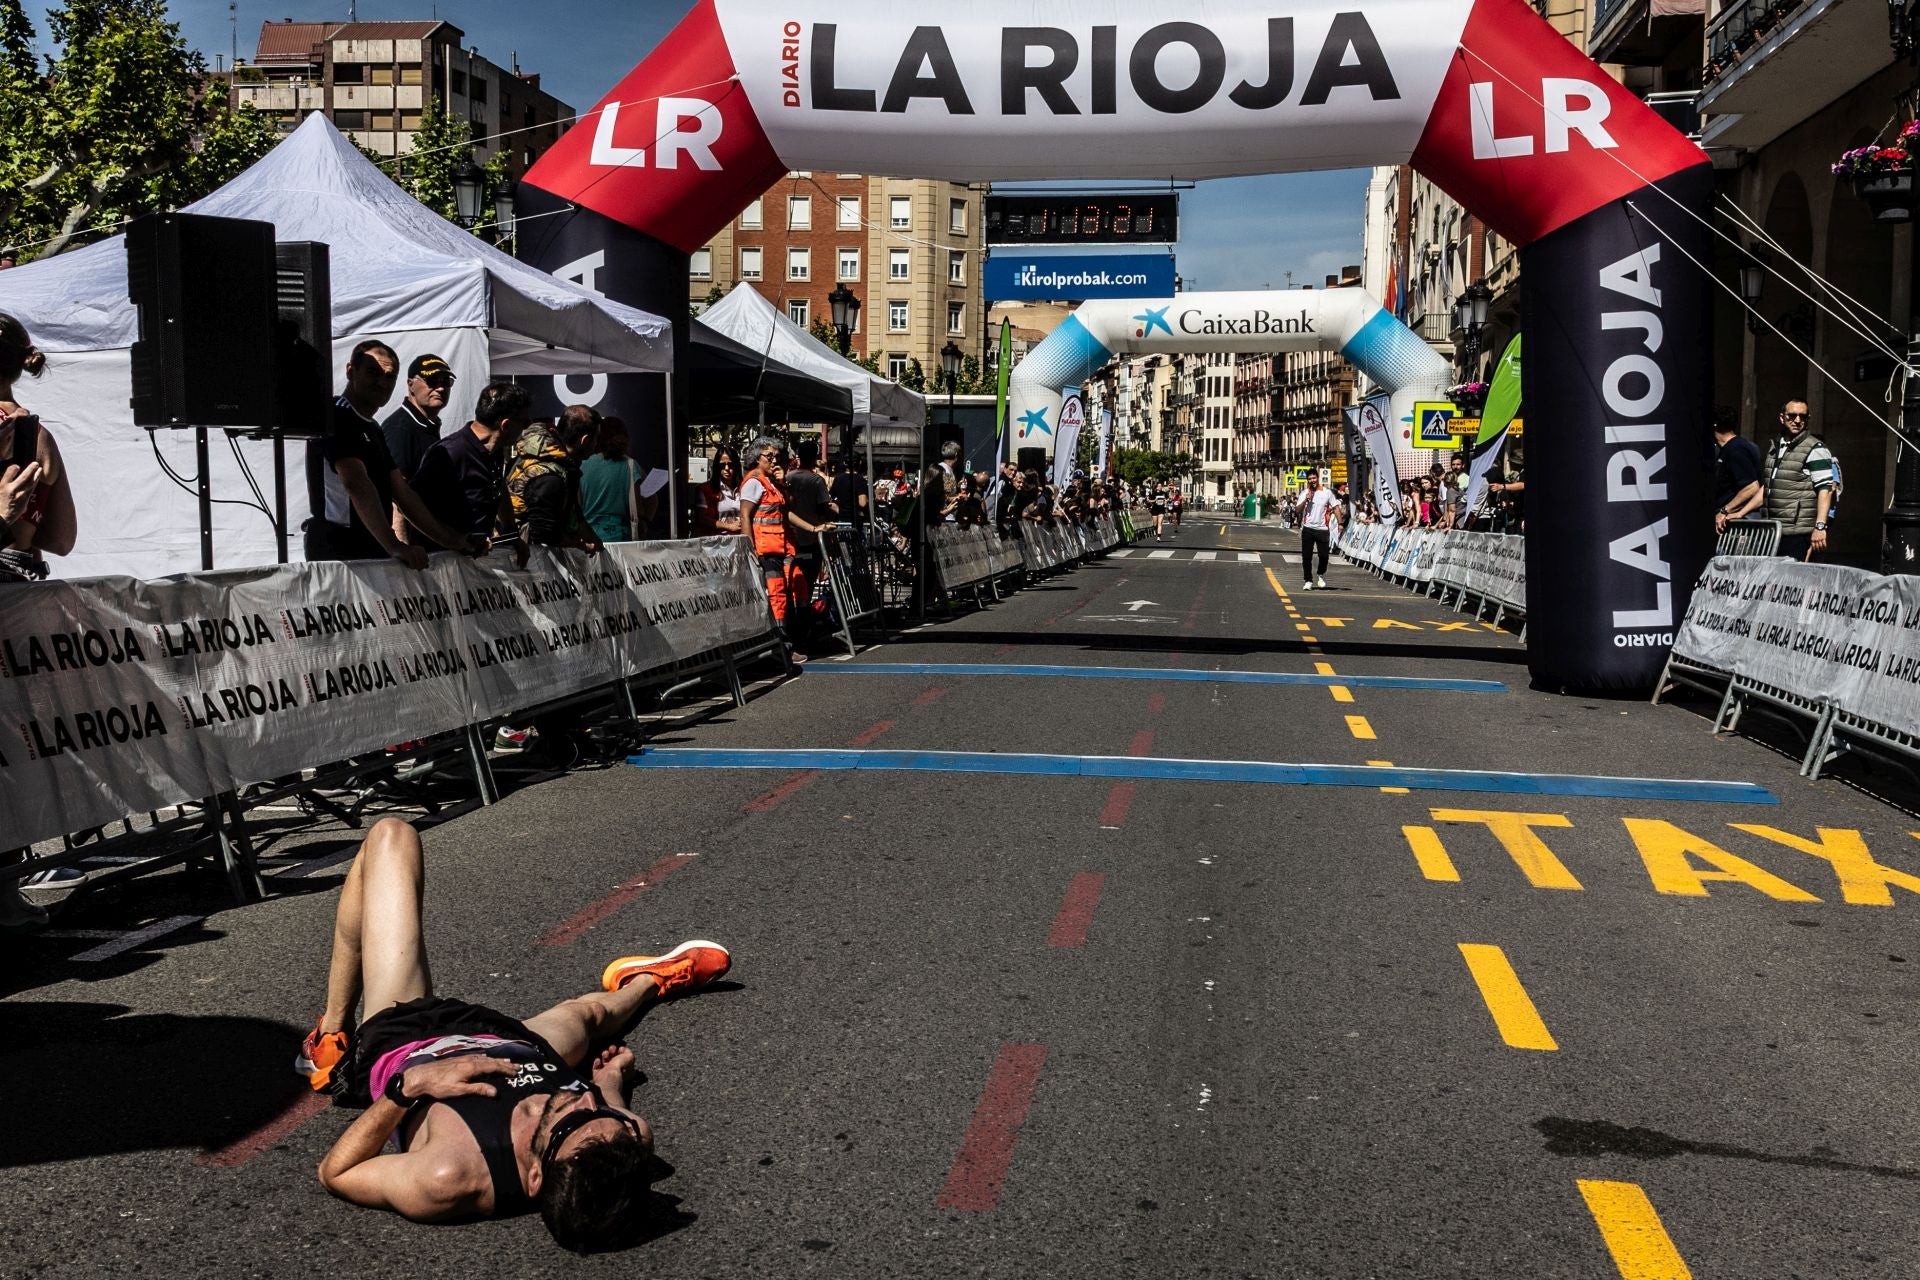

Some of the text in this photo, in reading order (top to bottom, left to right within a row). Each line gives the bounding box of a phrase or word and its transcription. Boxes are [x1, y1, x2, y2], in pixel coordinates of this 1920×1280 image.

[783, 21, 801, 107] DIARIO
[810, 11, 1401, 115] LA RIOJA
[590, 97, 723, 171] LR
[1469, 77, 1619, 160] LR
[1021, 271, 1147, 289] Kirolprobak.com
[1179, 309, 1316, 336] CaixaBank
[1600, 242, 1673, 628] LA RIOJA
[160, 613, 275, 657] LA RIOJA
[285, 601, 376, 638] LA RIOJA
[1614, 633, 1673, 647] DIARIO
[3, 627, 146, 677] LA RIOJA
[421, 648, 468, 680] RIOJA
[1901, 657, 1920, 685] RIO
[182, 678, 298, 728] LA RIOJA
[308, 660, 398, 702] LA RIOJA
[29, 716, 79, 758] LA
[74, 701, 168, 750] RIOJA
[1429, 808, 1920, 907] TAX
